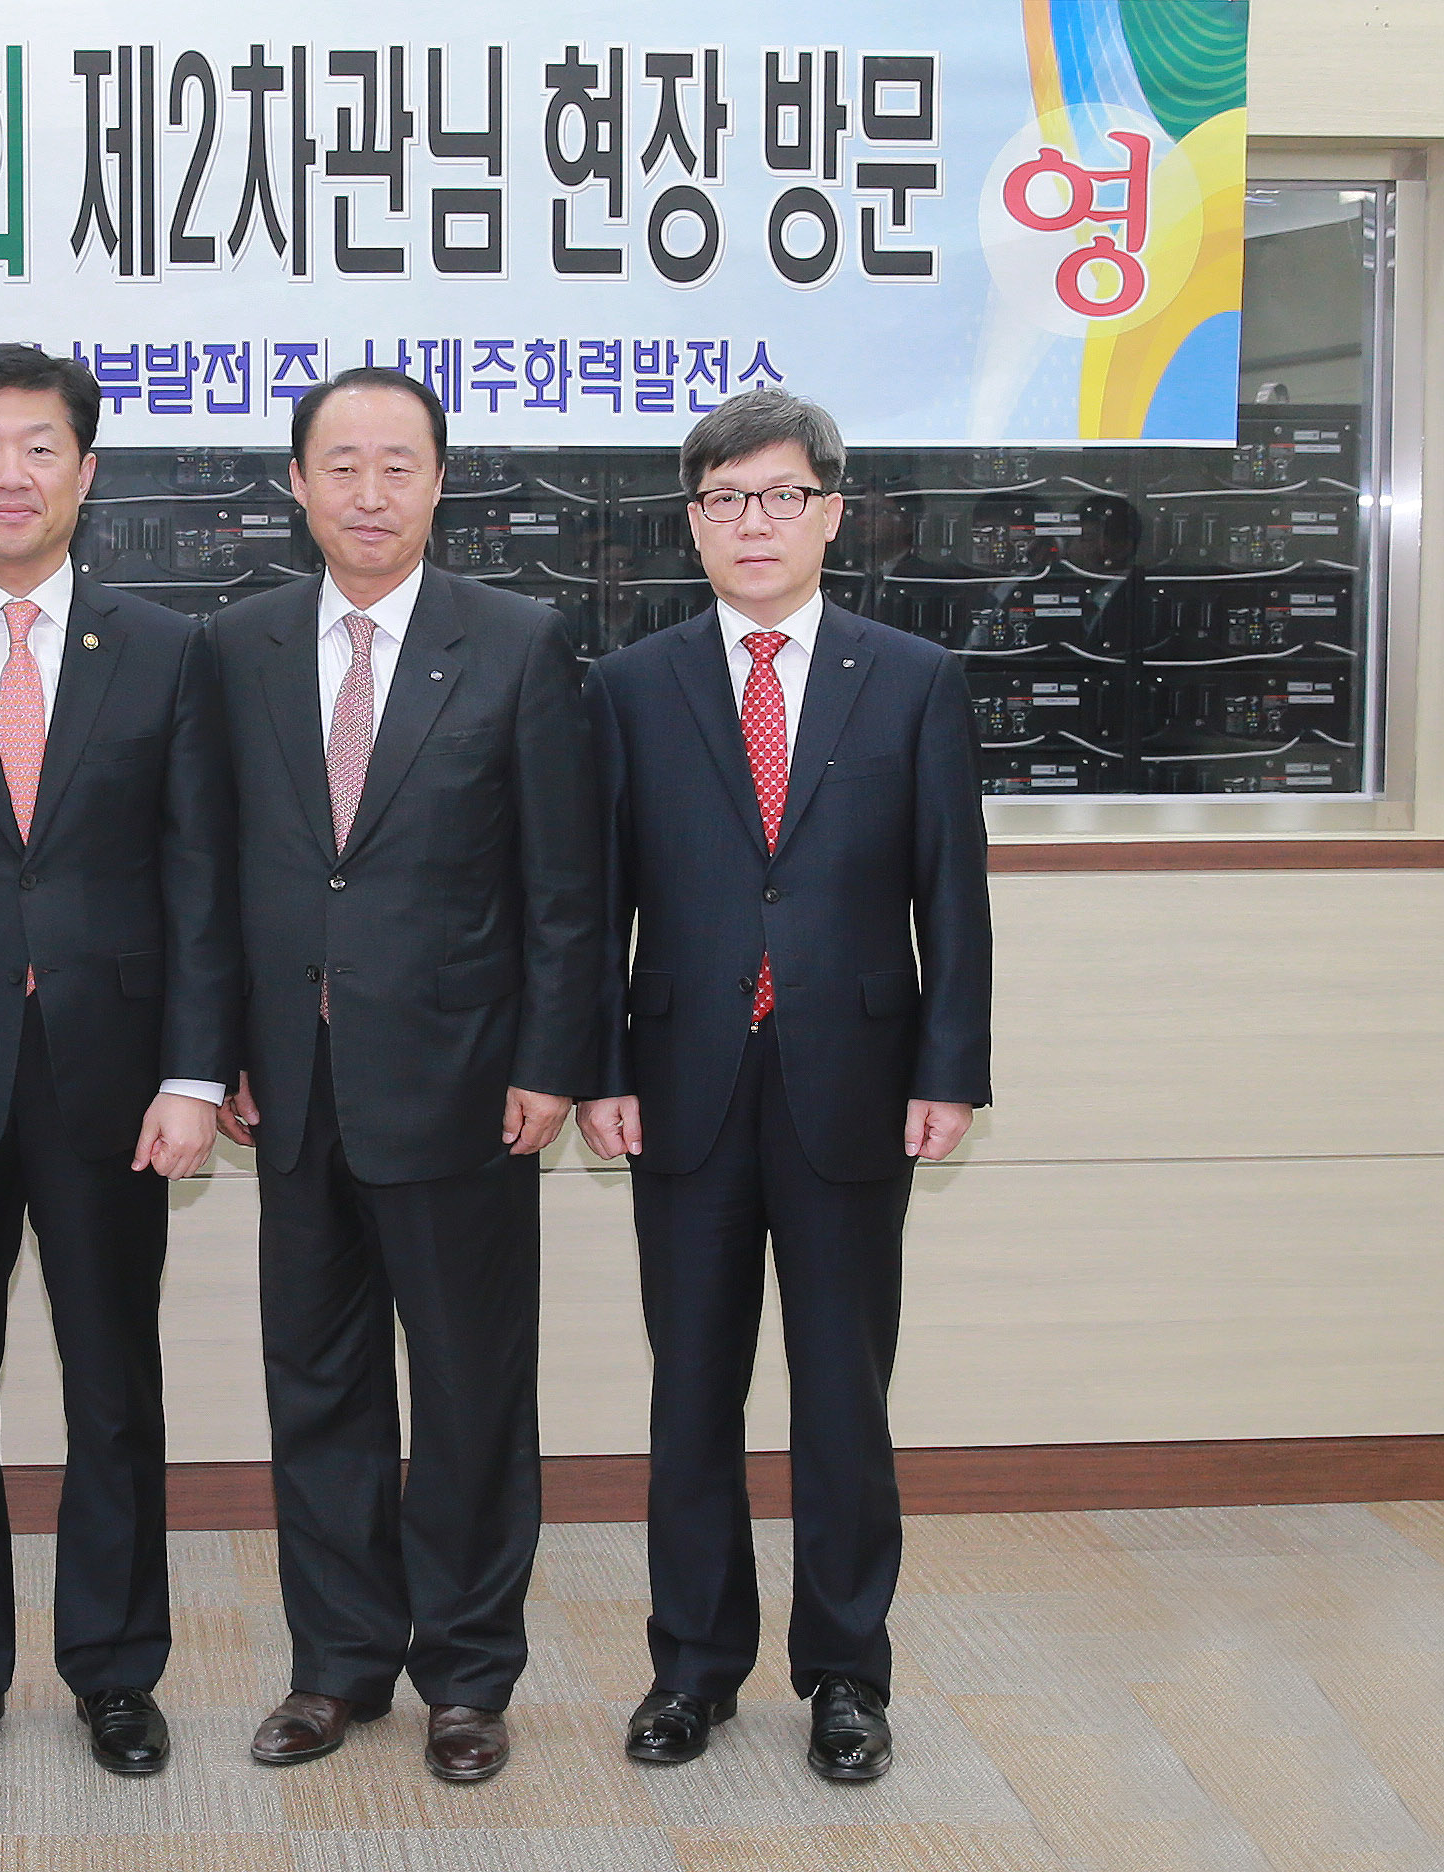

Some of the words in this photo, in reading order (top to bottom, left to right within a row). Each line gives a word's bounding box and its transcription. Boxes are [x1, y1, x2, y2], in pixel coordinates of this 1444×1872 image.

[70, 44, 503, 279] 제2차관님
[544, 44, 728, 284] 현장
[763, 49, 937, 284] 방문
[1002, 130, 1152, 318] 영
